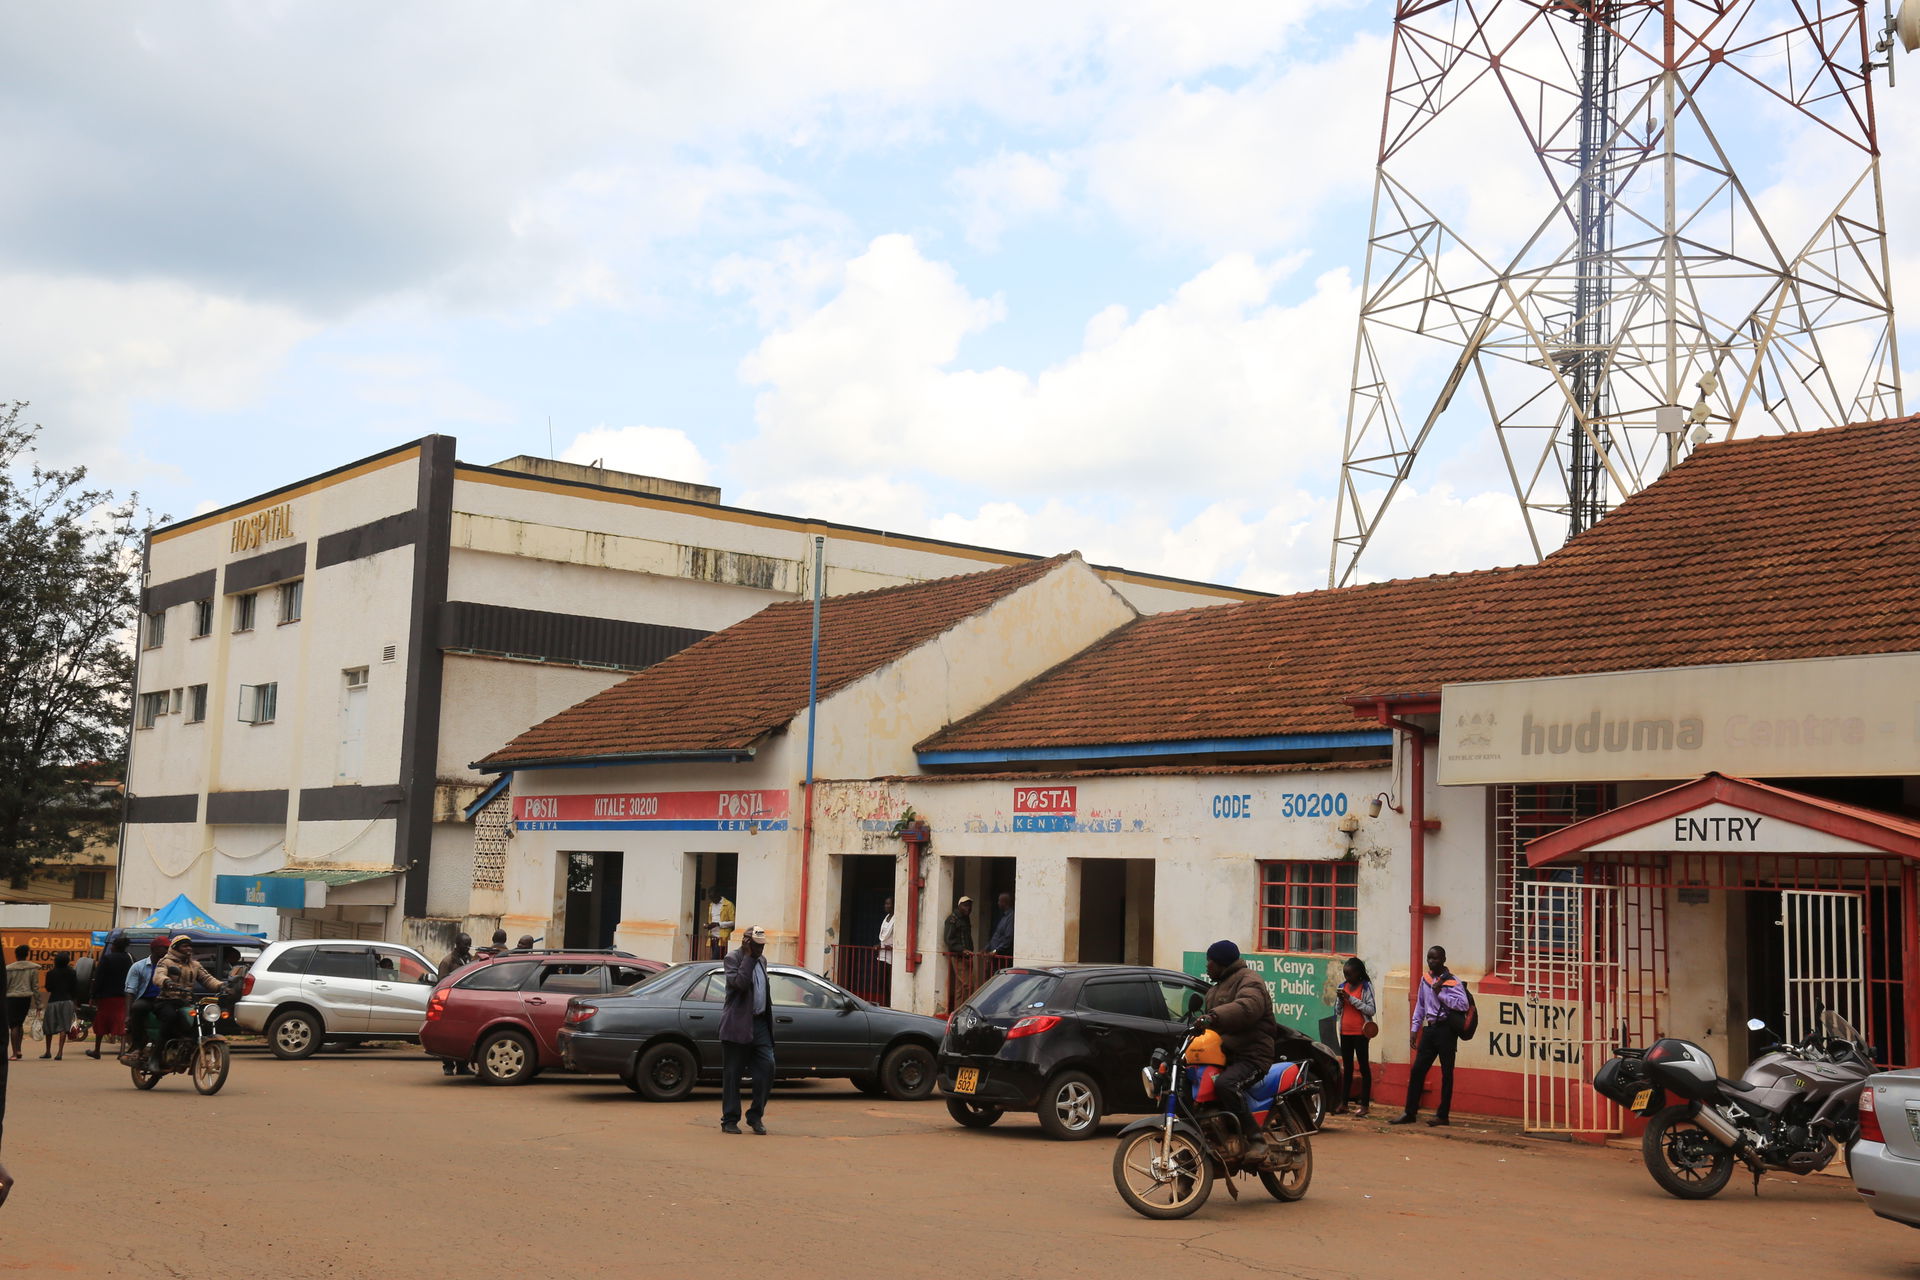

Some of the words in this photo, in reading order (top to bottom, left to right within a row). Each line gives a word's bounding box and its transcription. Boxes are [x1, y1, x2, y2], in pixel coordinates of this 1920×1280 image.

[230, 504, 294, 554] HOSPITAL
[1521, 711, 1704, 755] huduma
[1725, 714, 1866, 747] Centre
[594, 797, 625, 816] KITALE
[629, 796, 658, 816] 30200
[1018, 790, 1072, 809] POSTA
[1213, 795, 1251, 818] CODE
[1282, 792, 1348, 817] 30200
[523, 822, 558, 831] KENYA
[1016, 818, 1071, 829] KENYA
[1675, 817, 1763, 842] ENTRY
[1273, 957, 1315, 978] Kenya
[1272, 999, 1308, 1021] ivery.
[1500, 1001, 1577, 1031] ENTRY
